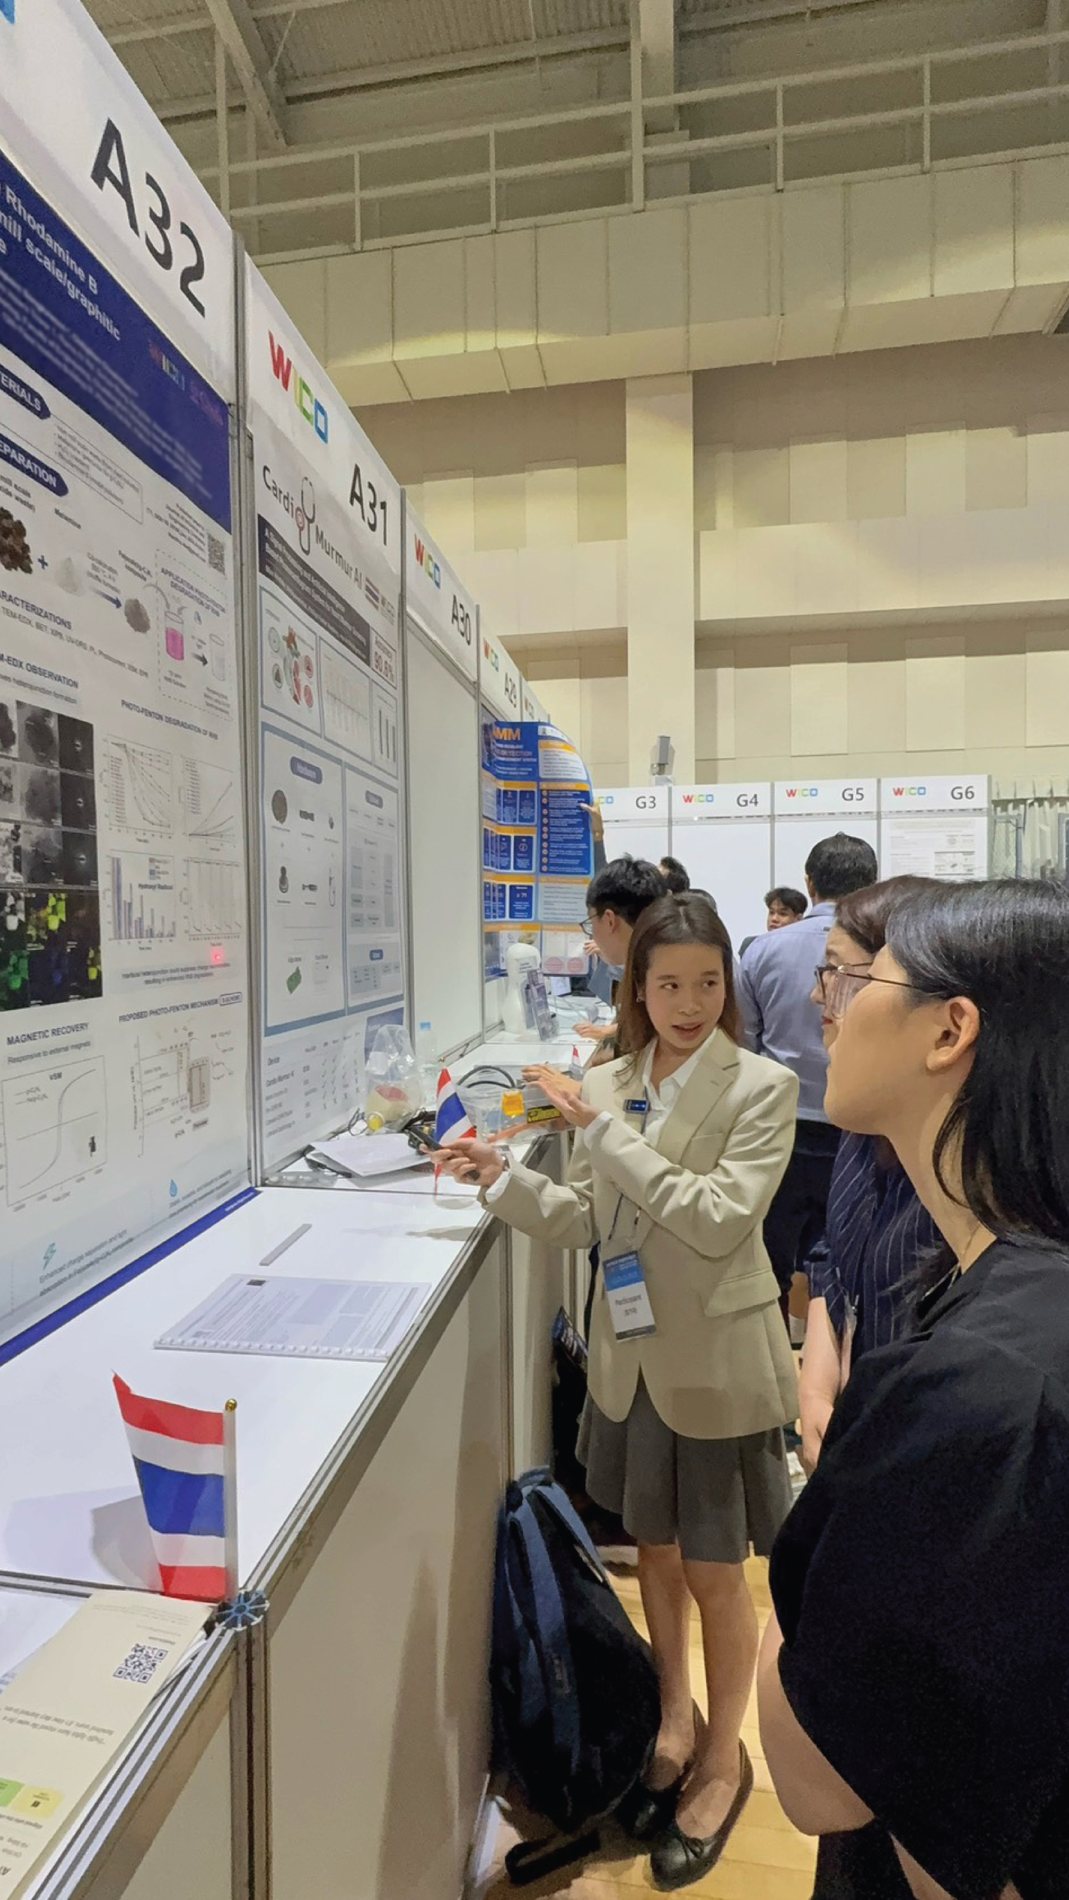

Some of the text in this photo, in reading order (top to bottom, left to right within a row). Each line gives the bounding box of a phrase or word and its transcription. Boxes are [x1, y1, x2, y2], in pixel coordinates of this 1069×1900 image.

[90, 117, 206, 319] A32
[5, 184, 86, 283] Rhodamine
[88, 273, 98, 295] B
[26, 238, 121, 342] scale/graphitic
[268, 329, 329, 445] WICO
[349, 463, 388, 546] A31
[315, 525, 353, 576] Murmur
[414, 532, 442, 590] WICO
[451, 593, 472, 646] A30
[25, 662, 79, 689] OBSERVATION
[635, 795, 657, 810] G3
[682, 793, 715, 804] WICO
[736, 793, 759, 808] G4
[785, 787, 818, 798] WICO
[841, 787, 864, 802] G5
[892, 786, 927, 797] WICO
[950, 785, 975, 801] G6
[6, 1022, 90, 1046] MAGNETIC RECOVERY
